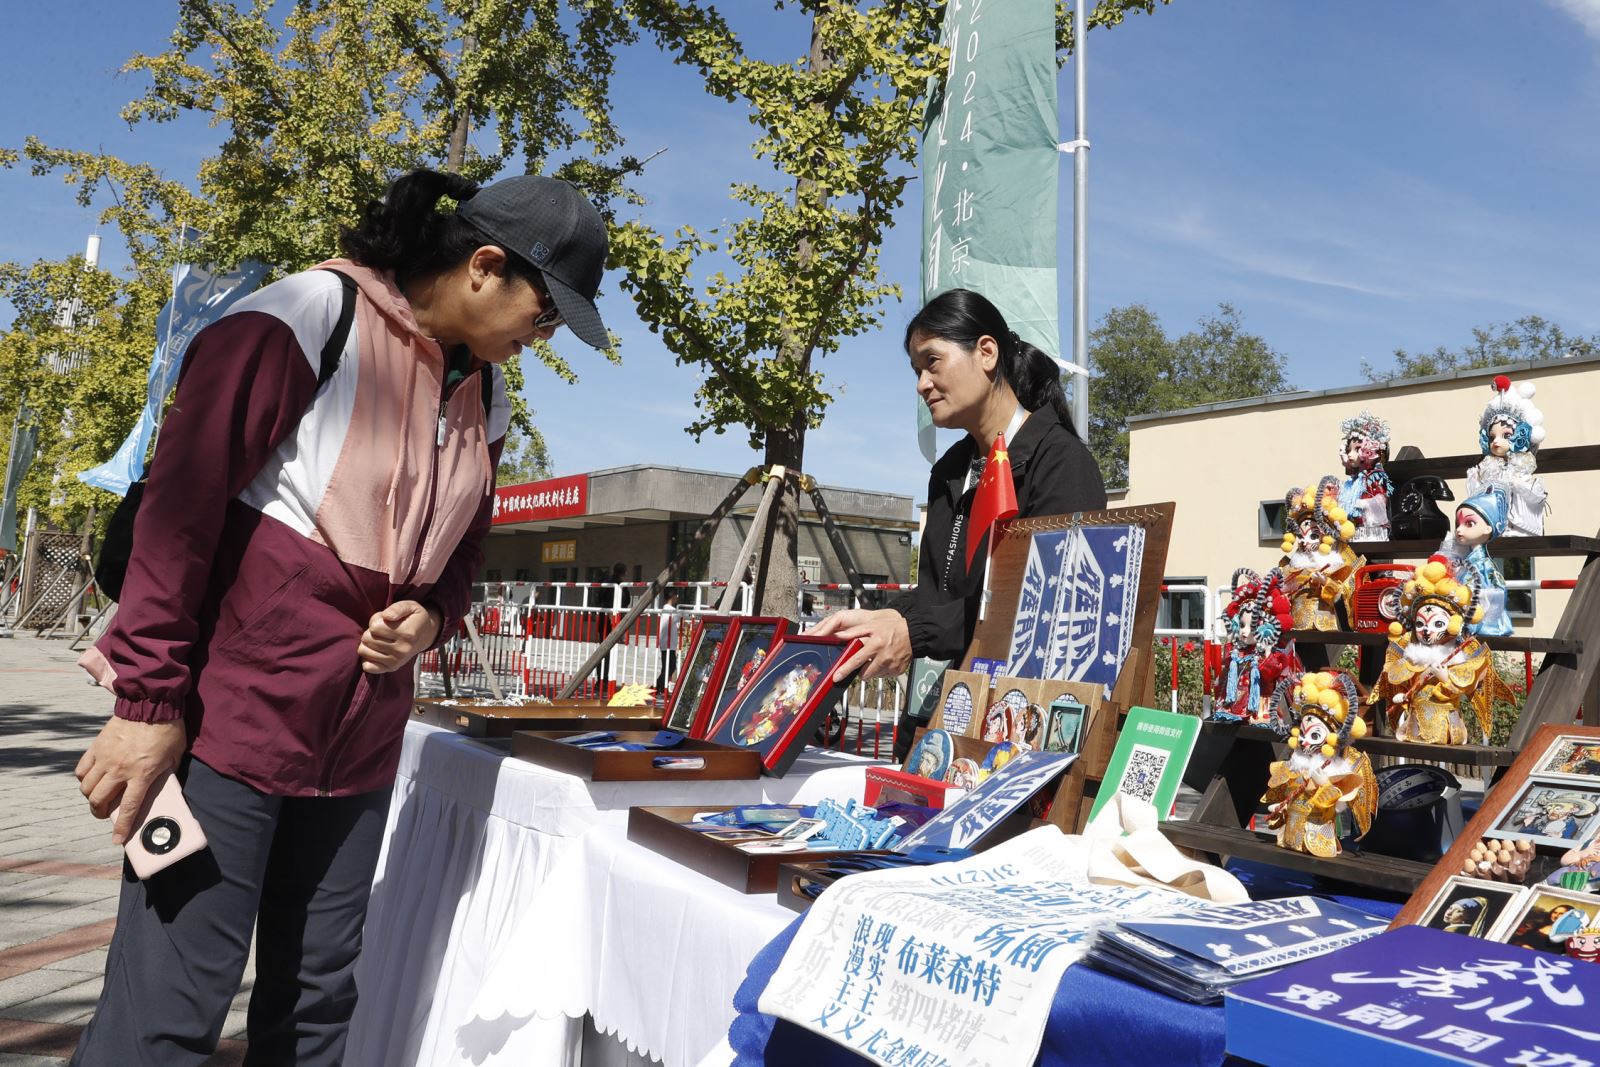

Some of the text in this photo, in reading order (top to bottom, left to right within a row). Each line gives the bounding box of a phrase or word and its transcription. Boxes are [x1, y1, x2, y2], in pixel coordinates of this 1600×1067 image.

[946, 513, 964, 561] FASHIONS
[1357, 620, 1378, 628] RADIO
[810, 912, 876, 1029] 浪漫主义
[842, 918, 898, 1041] 现实主义
[895, 934, 1004, 1007] 布莱希特
[859, 1027, 954, 1067] 尤金奥尼
[881, 979, 989, 1052] 第四堵墙
